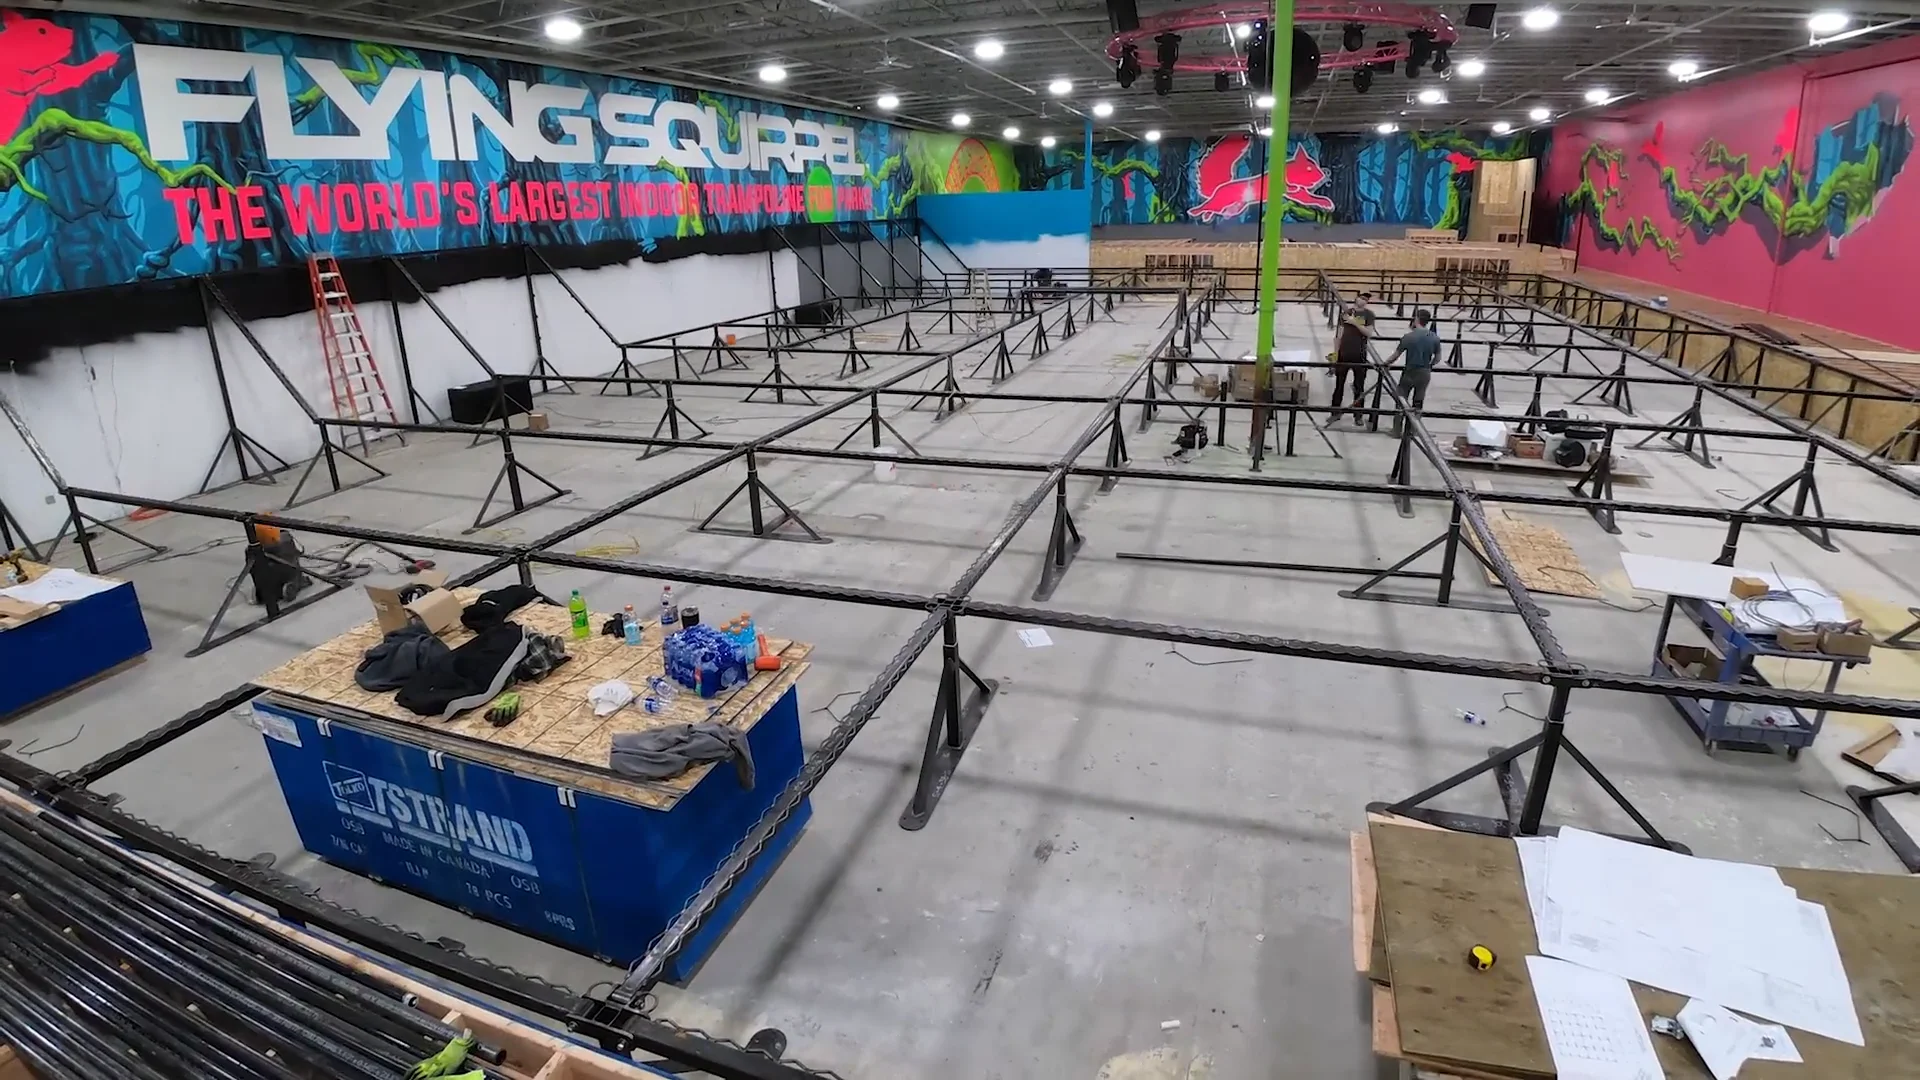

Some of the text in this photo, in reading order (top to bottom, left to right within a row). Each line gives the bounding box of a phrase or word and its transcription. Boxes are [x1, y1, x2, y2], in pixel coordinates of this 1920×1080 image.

[133, 43, 865, 176] FLYING SQUIRREL
[162, 185, 272, 245] THE
[278, 181, 480, 238] WORLD'S
[489, 181, 612, 224] LARGEST
[617, 181, 700, 218] INDOOR
[703, 182, 805, 215] TRAMPOLINE
[807, 184, 834, 214] FUN
[381, 831, 417, 853] MADE
[419, 844, 434, 858] IN
[437, 850, 492, 880] CANADA
[484, 888, 513, 909] PCS
[510, 874, 541, 896] OSB
